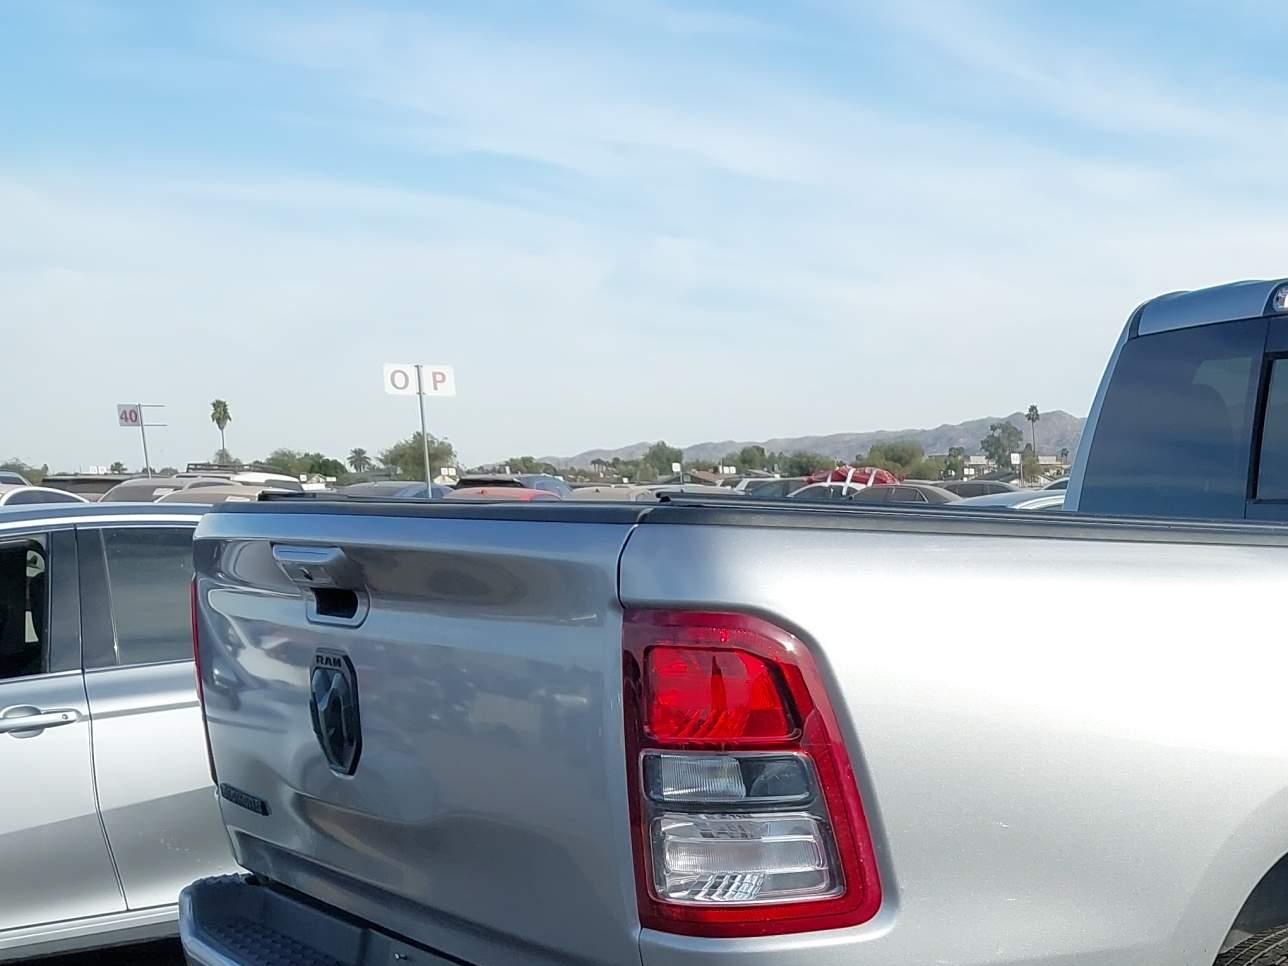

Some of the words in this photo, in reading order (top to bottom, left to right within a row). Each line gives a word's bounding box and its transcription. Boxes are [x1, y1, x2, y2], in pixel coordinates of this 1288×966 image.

[390, 369, 409, 391] O
[431, 370, 446, 391] P
[119, 409, 138, 423] 40
[315, 654, 342, 668] RAM
